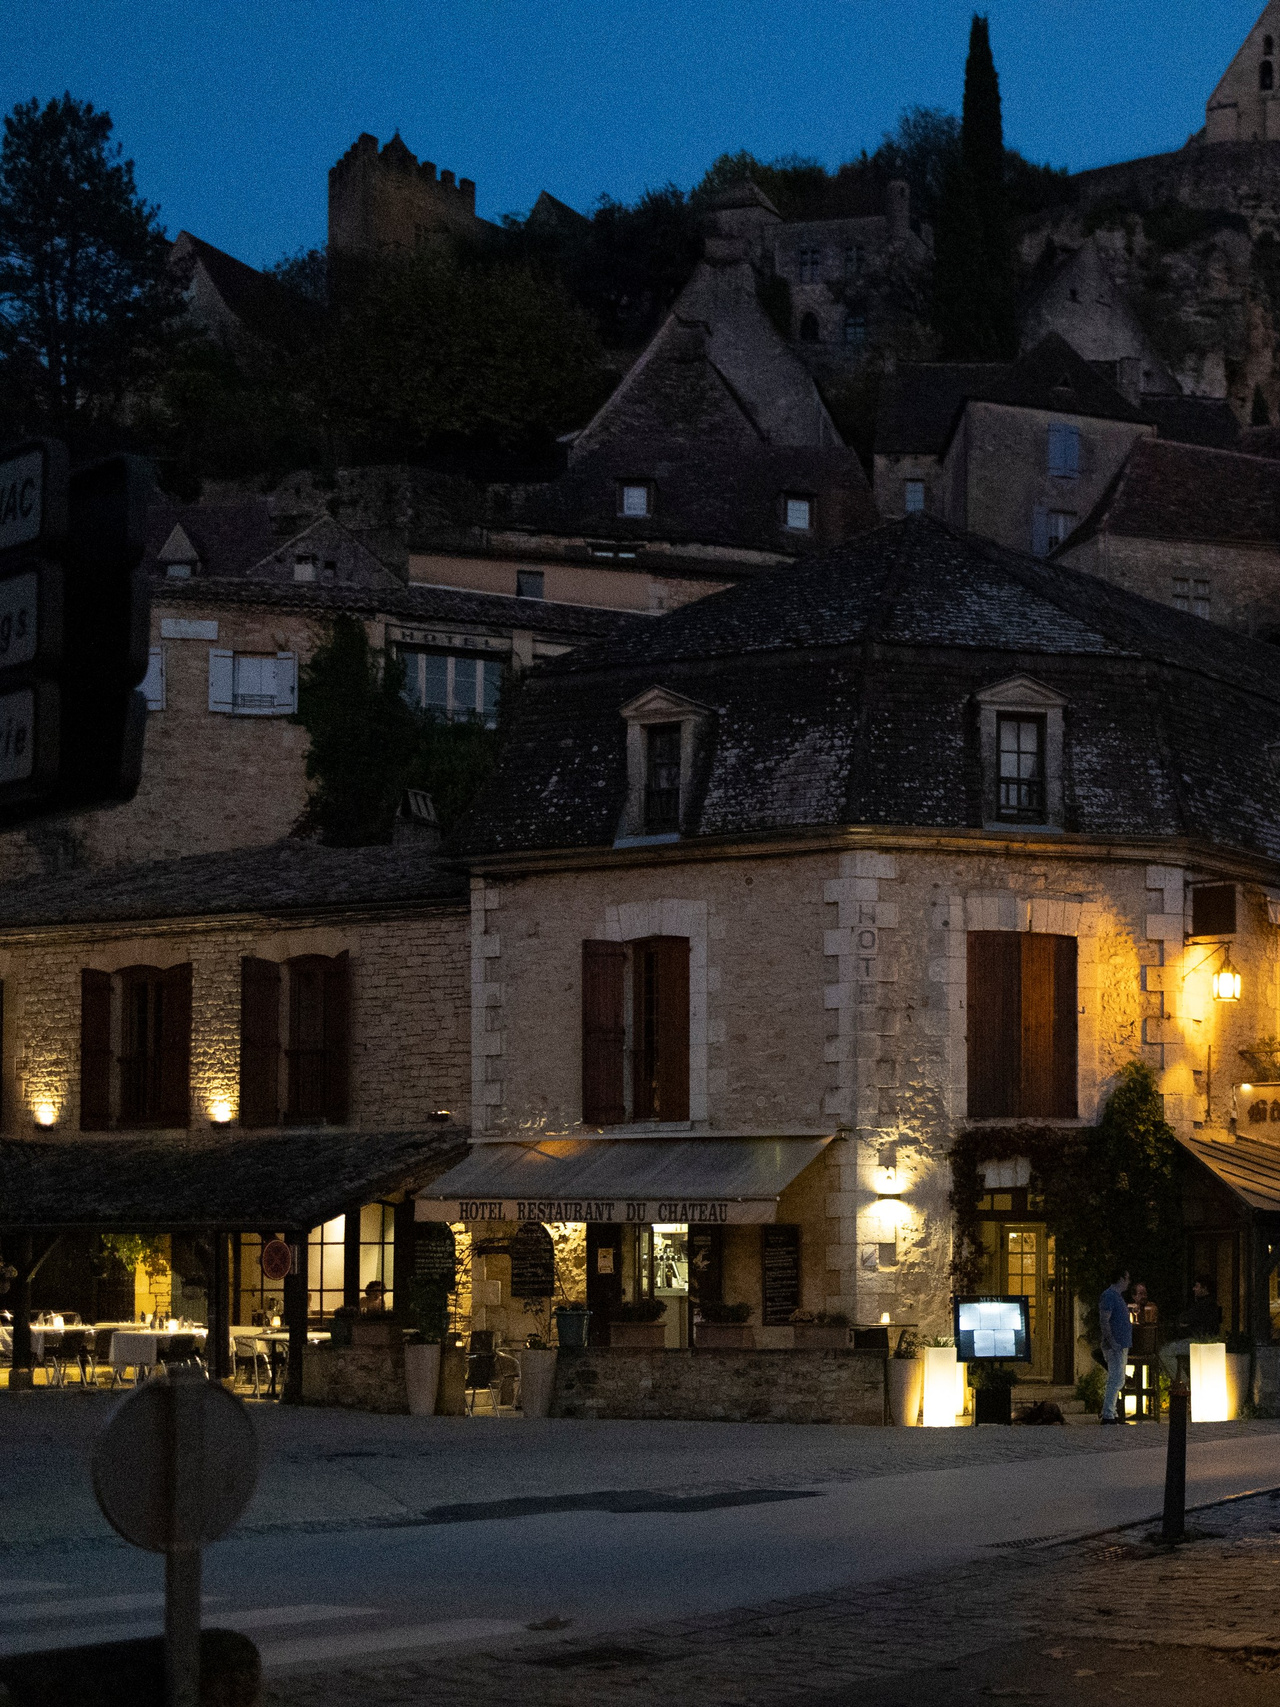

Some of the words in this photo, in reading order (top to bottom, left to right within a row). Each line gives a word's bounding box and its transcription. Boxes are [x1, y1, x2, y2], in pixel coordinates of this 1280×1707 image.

[401, 631, 494, 650] HOTEL
[459, 1202, 506, 1220] HOTEL
[517, 1202, 615, 1221] RESTAURANT
[626, 1203, 646, 1221] DU
[658, 1203, 729, 1222] CHATEAU
